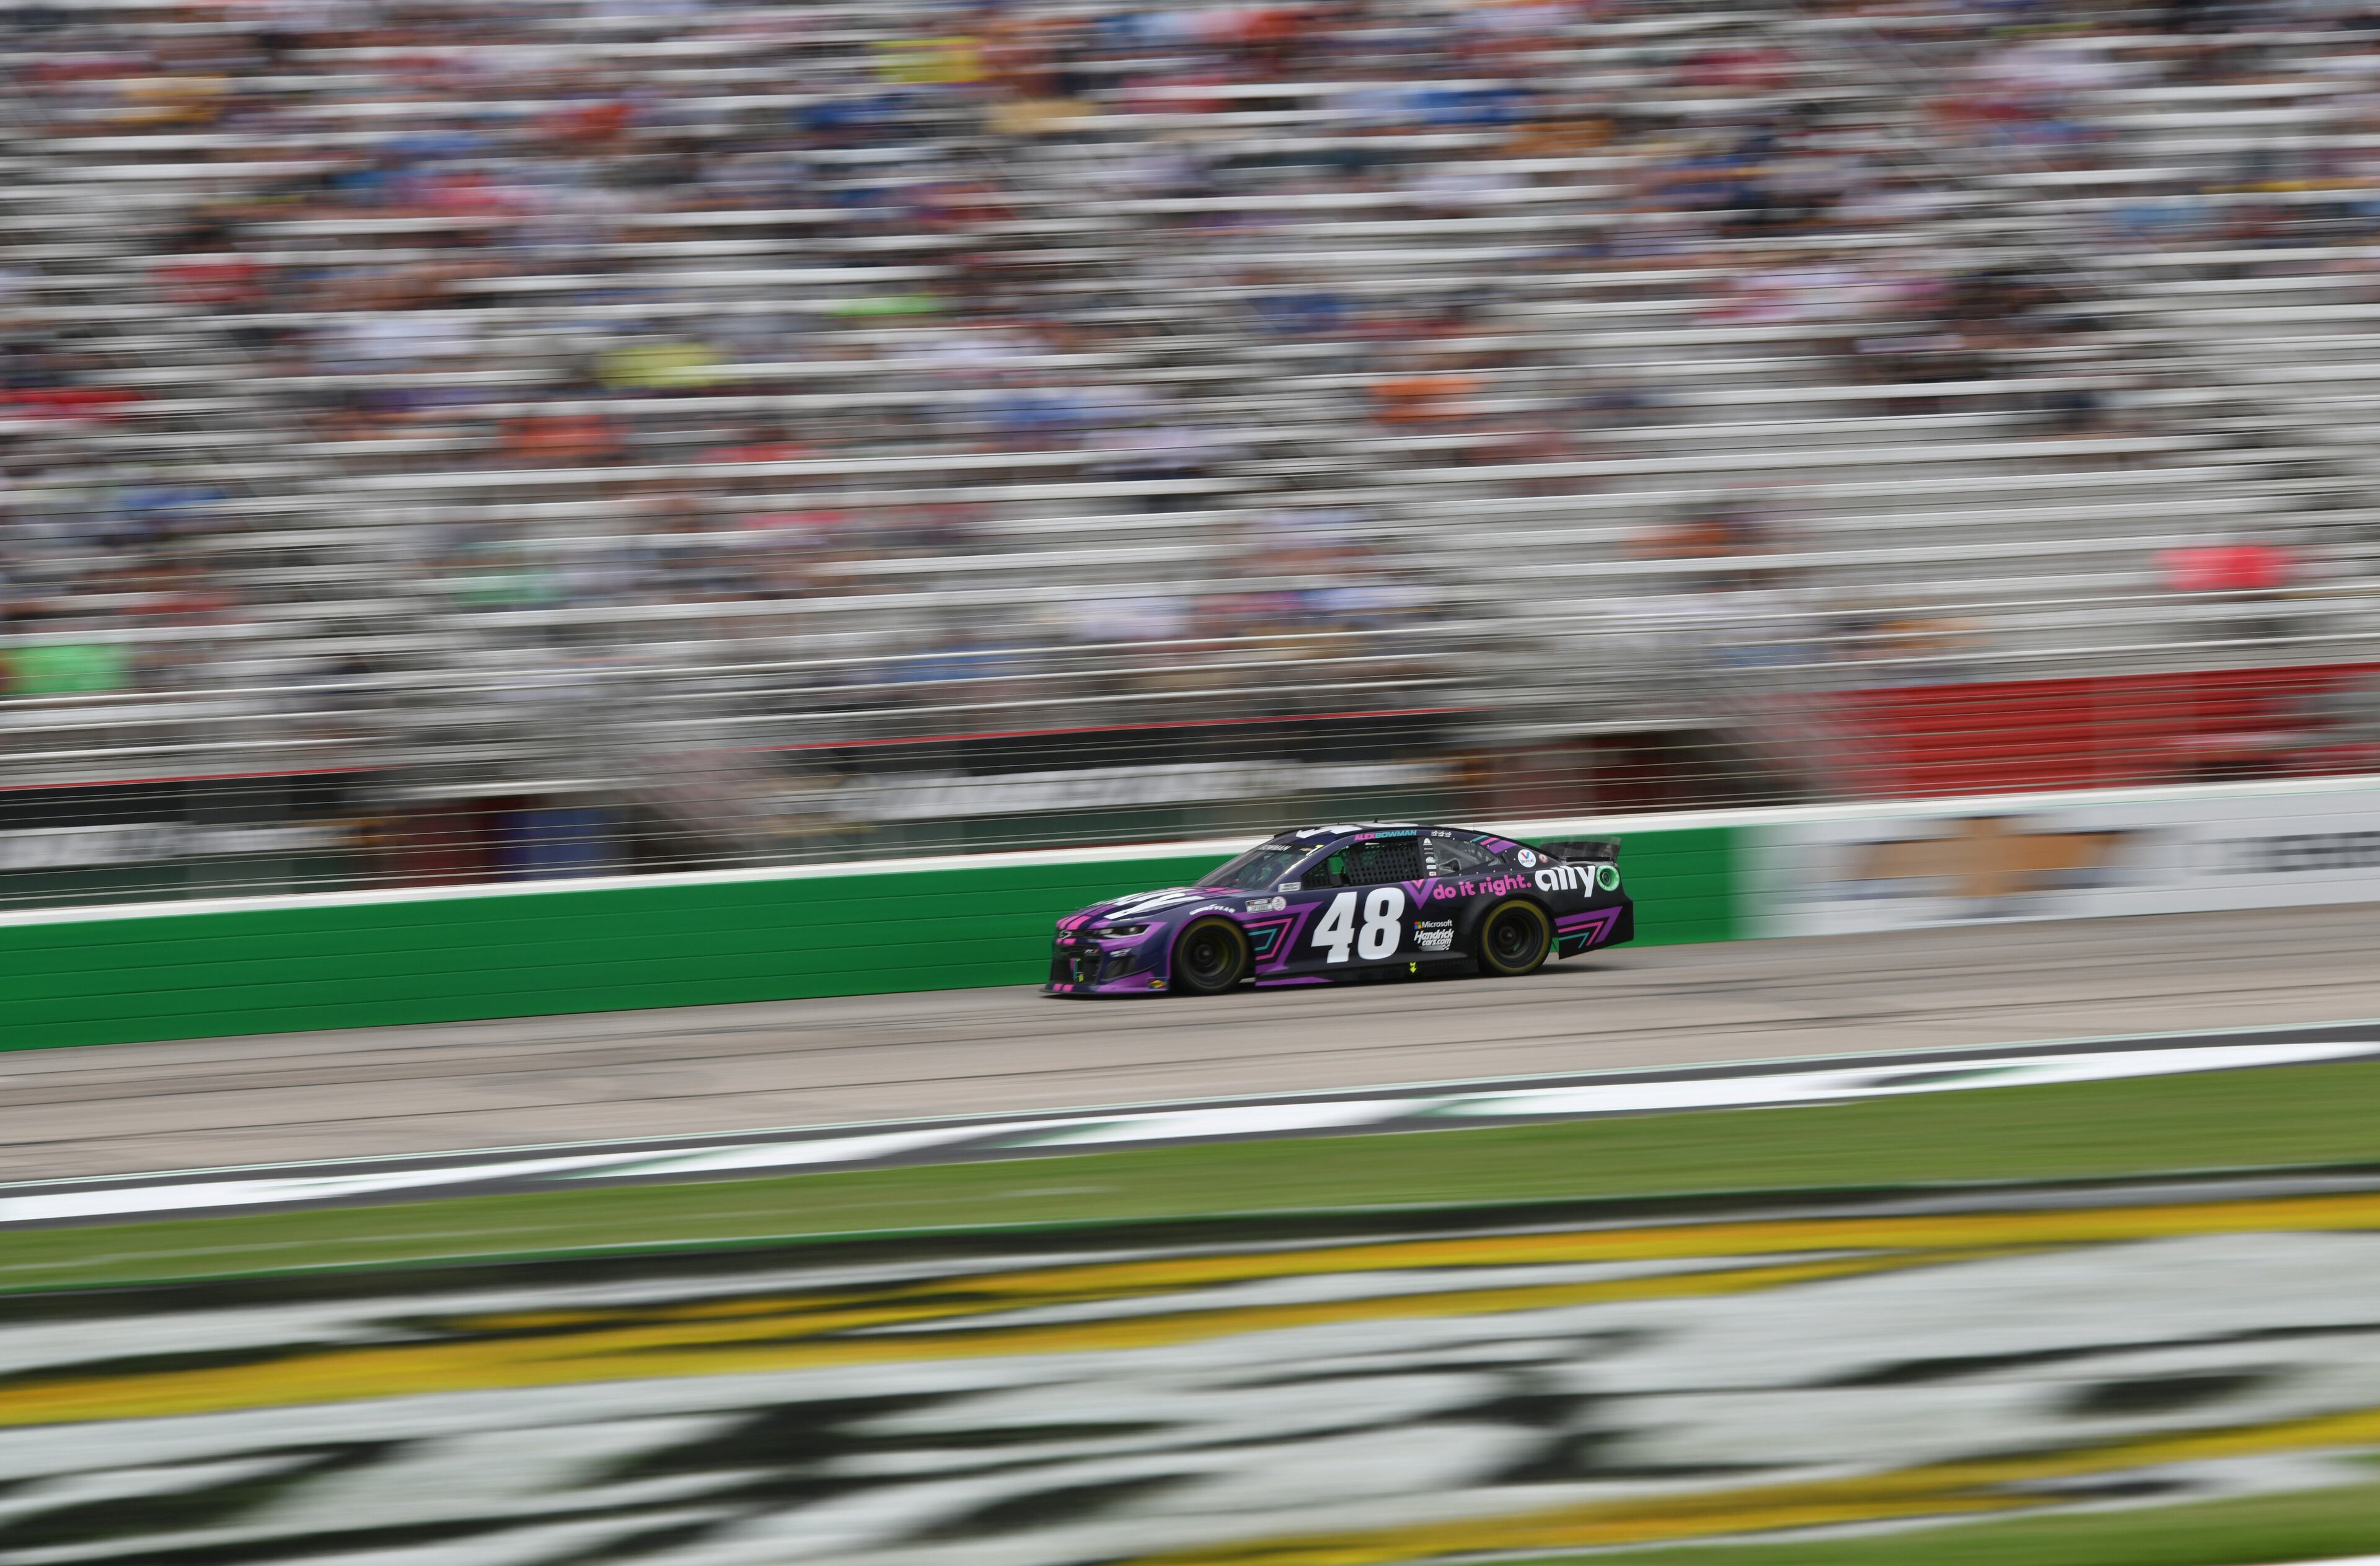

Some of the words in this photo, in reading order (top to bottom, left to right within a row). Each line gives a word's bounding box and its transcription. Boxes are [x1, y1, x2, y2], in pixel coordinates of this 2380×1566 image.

[1433, 884, 1457, 900] do
[1458, 881, 1476, 897] it
[1479, 874, 1532, 896] right.
[1535, 865, 1596, 898] ally
[1311, 887, 1405, 964] 48
[1422, 919, 1453, 928] Microsoft
[1414, 928, 1454, 944] Hendrick
[1422, 938, 1452, 946] cars.com
